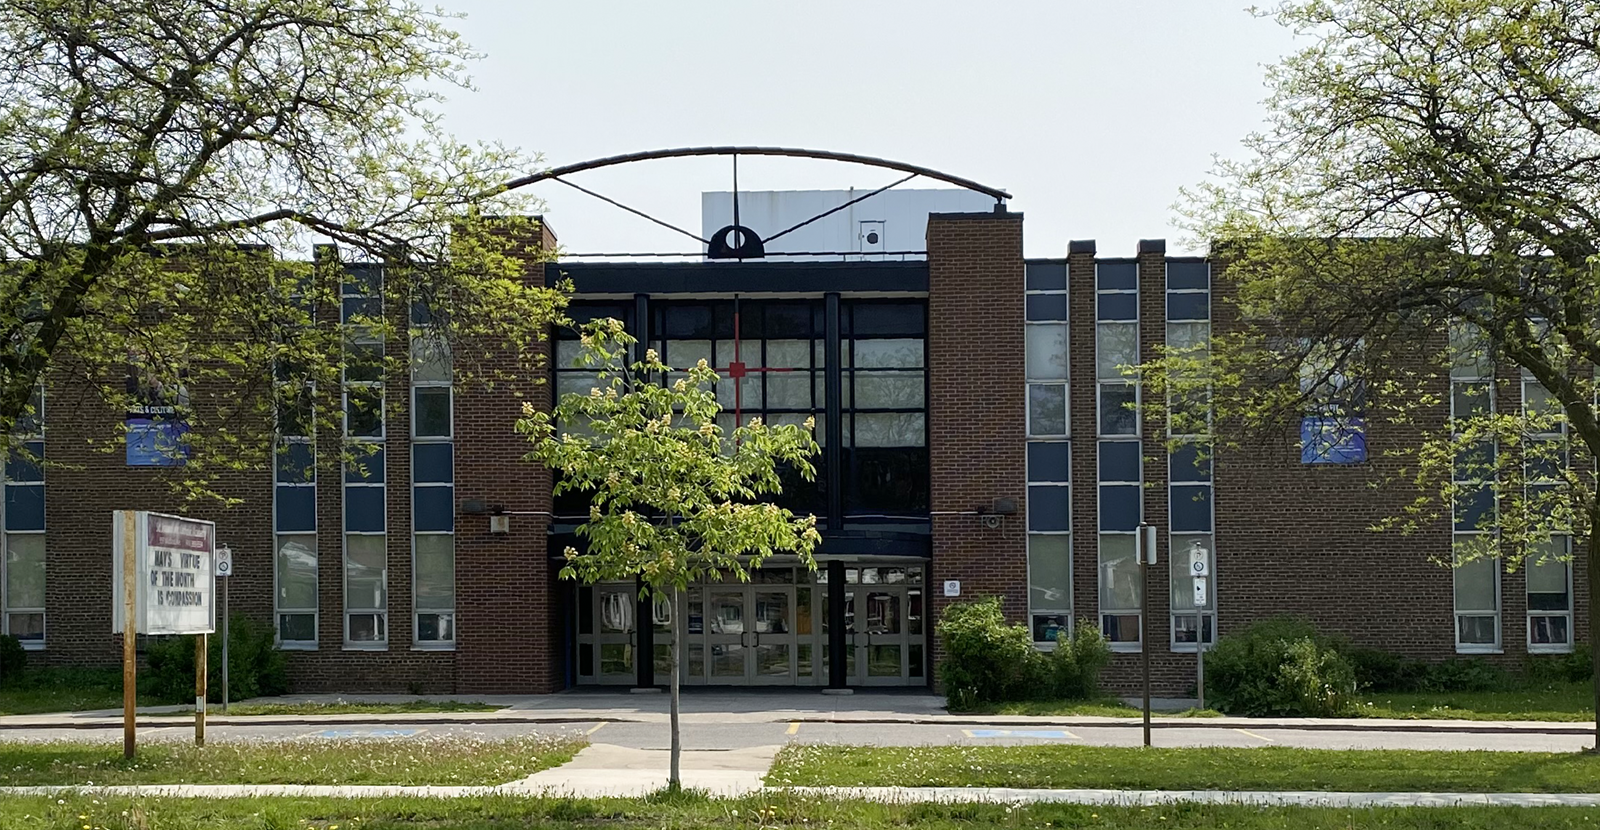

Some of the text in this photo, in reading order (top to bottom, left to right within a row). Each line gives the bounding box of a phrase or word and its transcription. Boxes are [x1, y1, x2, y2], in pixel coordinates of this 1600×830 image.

[150, 569, 195, 588] OF THE MONTH
[157, 589, 202, 607] IS COMPASSION
